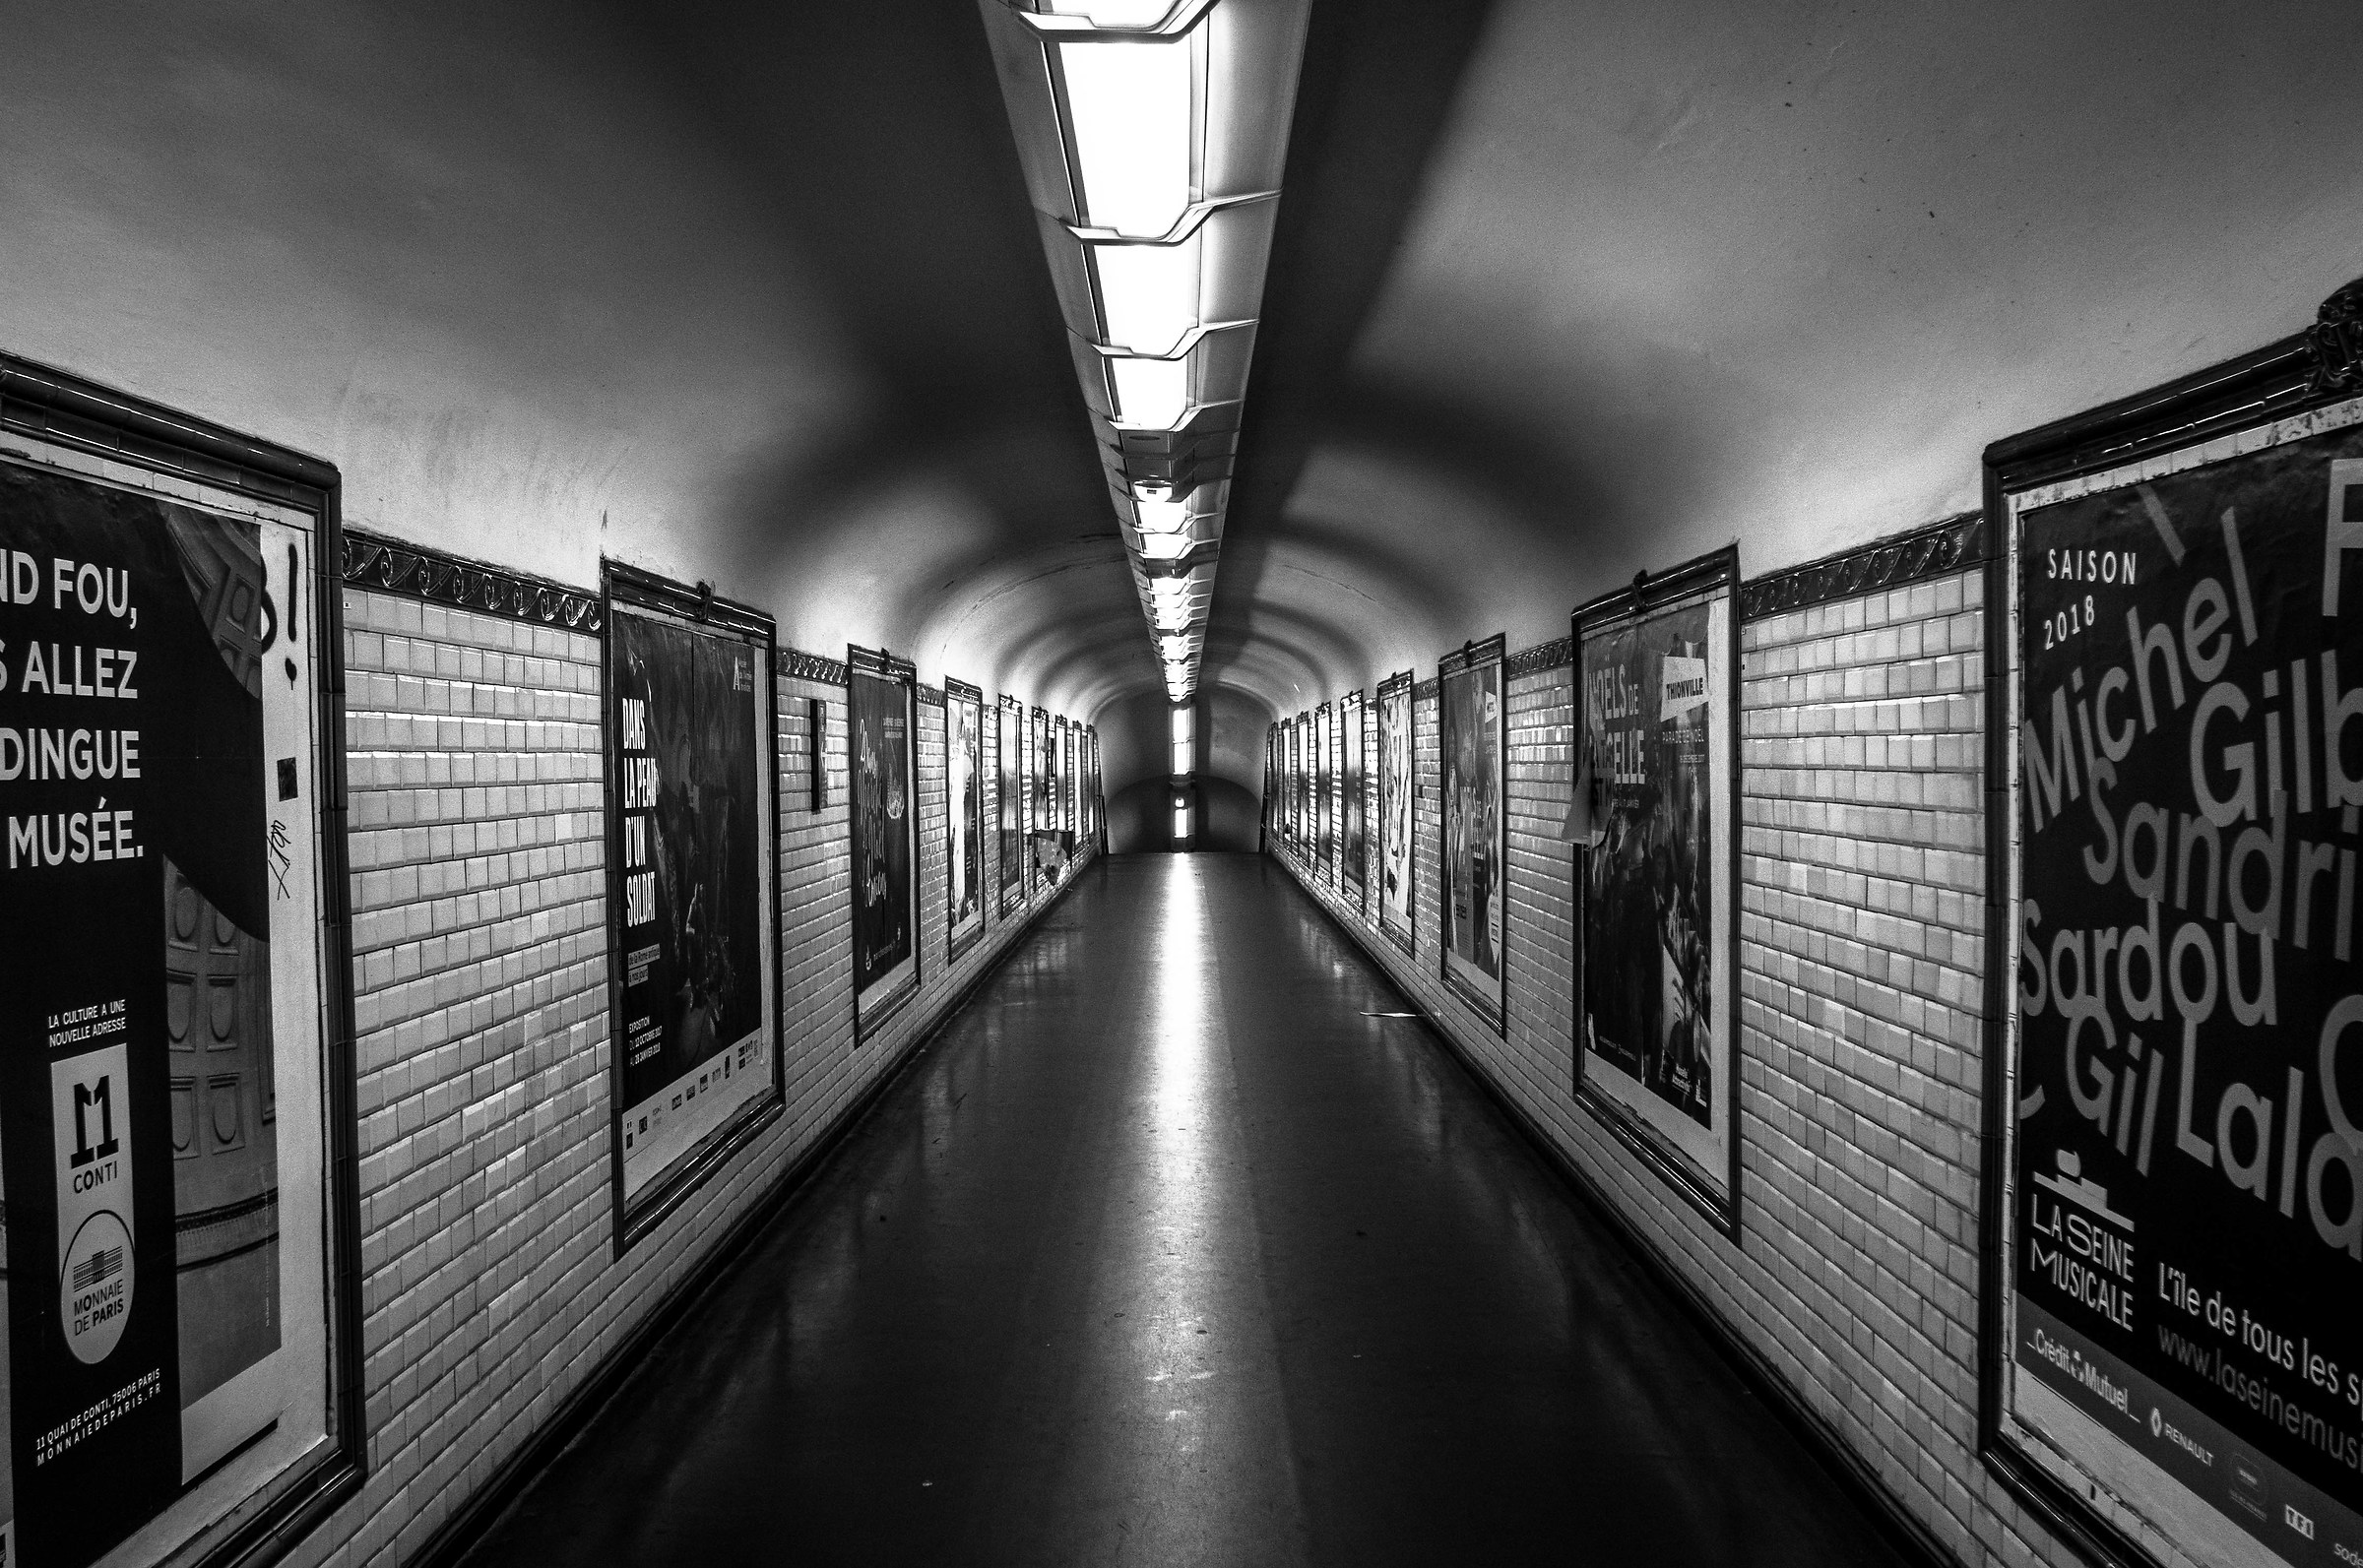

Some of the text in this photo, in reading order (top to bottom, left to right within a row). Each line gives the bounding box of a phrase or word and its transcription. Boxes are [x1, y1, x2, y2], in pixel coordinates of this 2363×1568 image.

[2048, 548, 2137, 585] SAISON
[53, 558, 137, 629] FOU,
[2043, 595, 2095, 651] 2018
[22, 641, 138, 698] ALLEZ
[1666, 677, 1703, 700] THIONVILLE
[2024, 506, 2259, 834] Michel
[622, 697, 646, 750] DANS
[1629, 684, 1639, 716] DE
[0, 727, 141, 781] DINGUE
[624, 757, 657, 809] LA PEAU
[9, 796, 144, 869] MUSÉE.
[625, 815, 646, 868] D'UN
[626, 871, 656, 927] SOLDAT
[2020, 894, 2277, 1026] Sardou
[48, 998, 126, 1029] LA CULTURE A UNE
[49, 1017, 127, 1048] NOUVELLE ADRESSE
[74, 1160, 117, 1194] CONTI
[2032, 1193, 2135, 1283] LA SEINE
[74, 1279, 123, 1316] MONNAIE
[2030, 1237, 2134, 1332] MUSICALE
[74, 1297, 124, 1337] DE PARIS
[2205, 1289, 2236, 1337] de
[2242, 1308, 2295, 1371] tous
[2302, 1337, 2339, 1396] les
[2034, 1327, 2129, 1414] Crédit Mutuel
[36, 1436, 45, 1451] 11
[47, 1422, 69, 1445] QUAI
[70, 1414, 82, 1430] DE
[112, 1382, 137, 1405] 75006
[138, 1367, 160, 1389] PARIS
[2164, 1422, 2214, 1467] RENAULT
[2286, 1506, 2314, 1537] TF1
